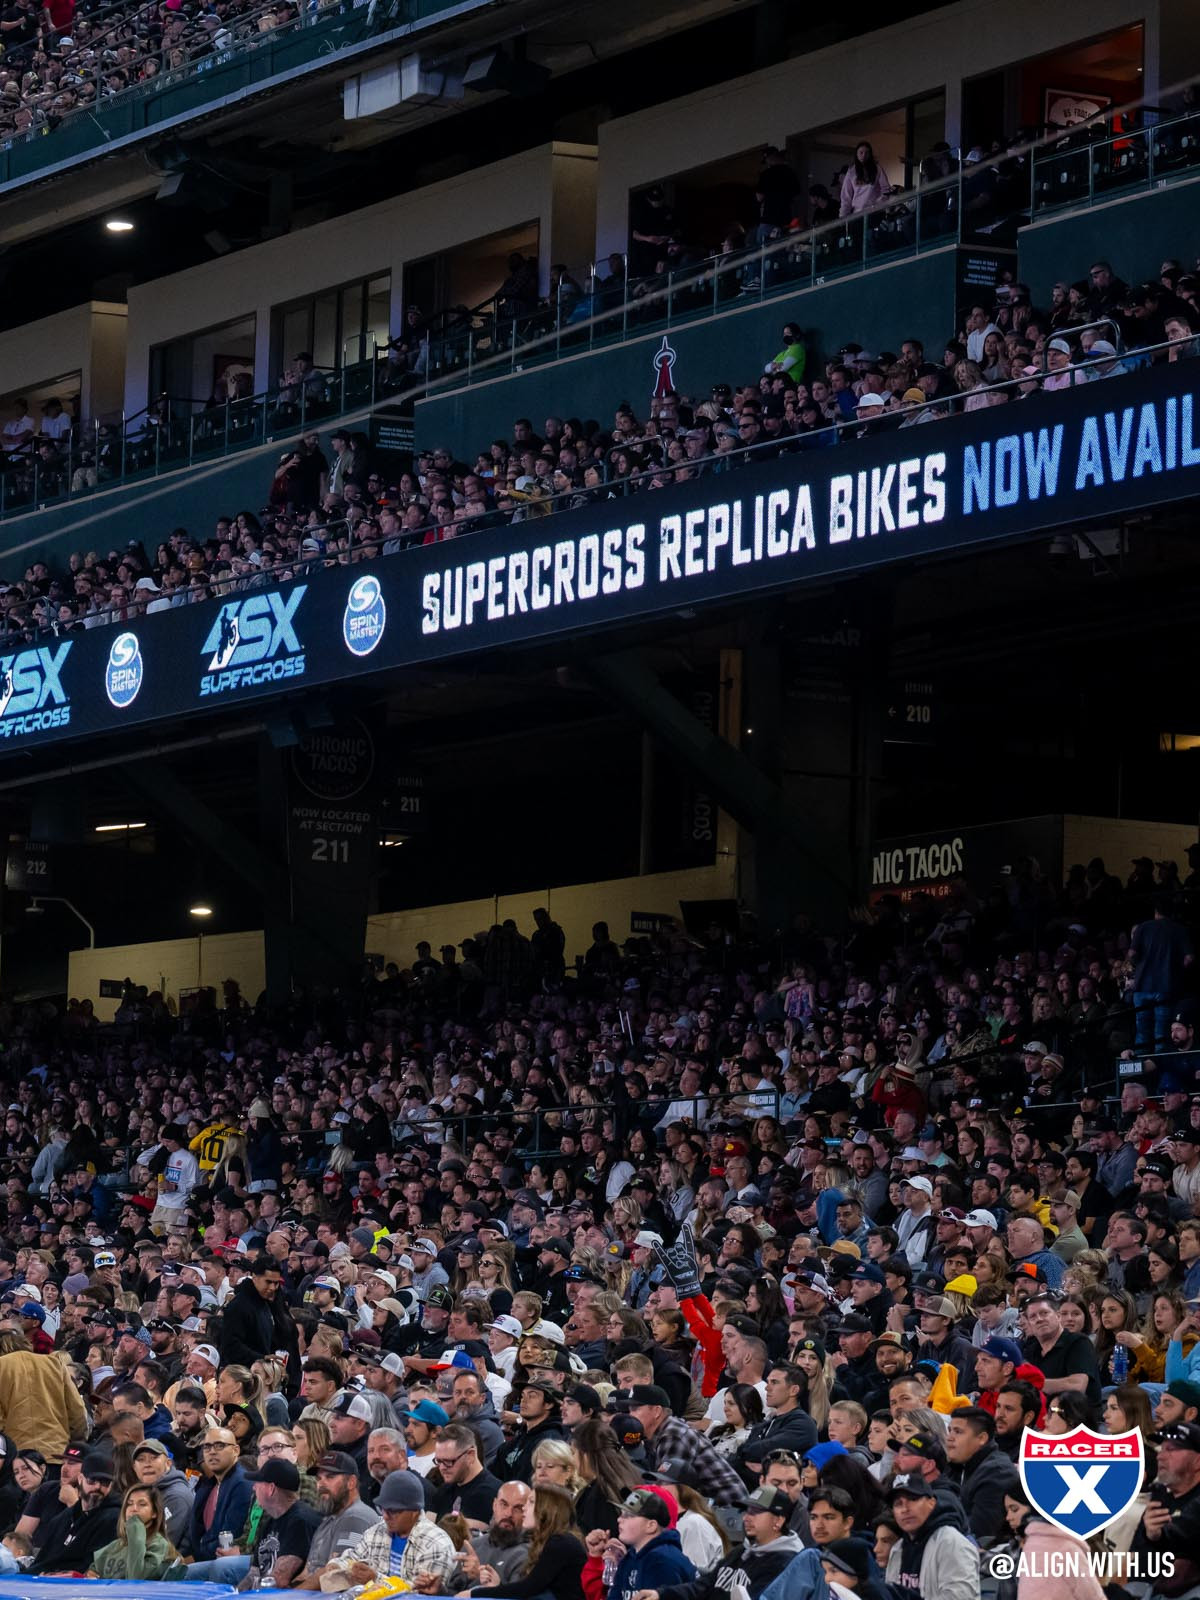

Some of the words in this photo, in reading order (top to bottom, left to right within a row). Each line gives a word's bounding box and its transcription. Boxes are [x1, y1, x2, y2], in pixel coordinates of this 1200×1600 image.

[421, 524, 646, 635] SUPERCROSS
[658, 487, 816, 582] REPLICA
[829, 452, 947, 546] BIKES
[963, 424, 1064, 515] NOW
[1075, 393, 1200, 491] AVAIL
[350, 614, 380, 630] SPIN
[350, 624, 381, 639] MASTER
[111, 668, 137, 683] SPIN
[199, 654, 306, 697] SUPERCROSS
[906, 704, 931, 724] 210
[400, 796, 421, 813] 211
[292, 807, 320, 818] NOW
[321, 808, 371, 823] LOCATED
[299, 820, 316, 830] AT
[315, 821, 363, 834] SECTION
[311, 837, 350, 864] 211
[25, 860, 49, 875] 212
[872, 847, 904, 885] NIC
[905, 837, 965, 881] TACOS
[200, 1136, 225, 1163] 10
